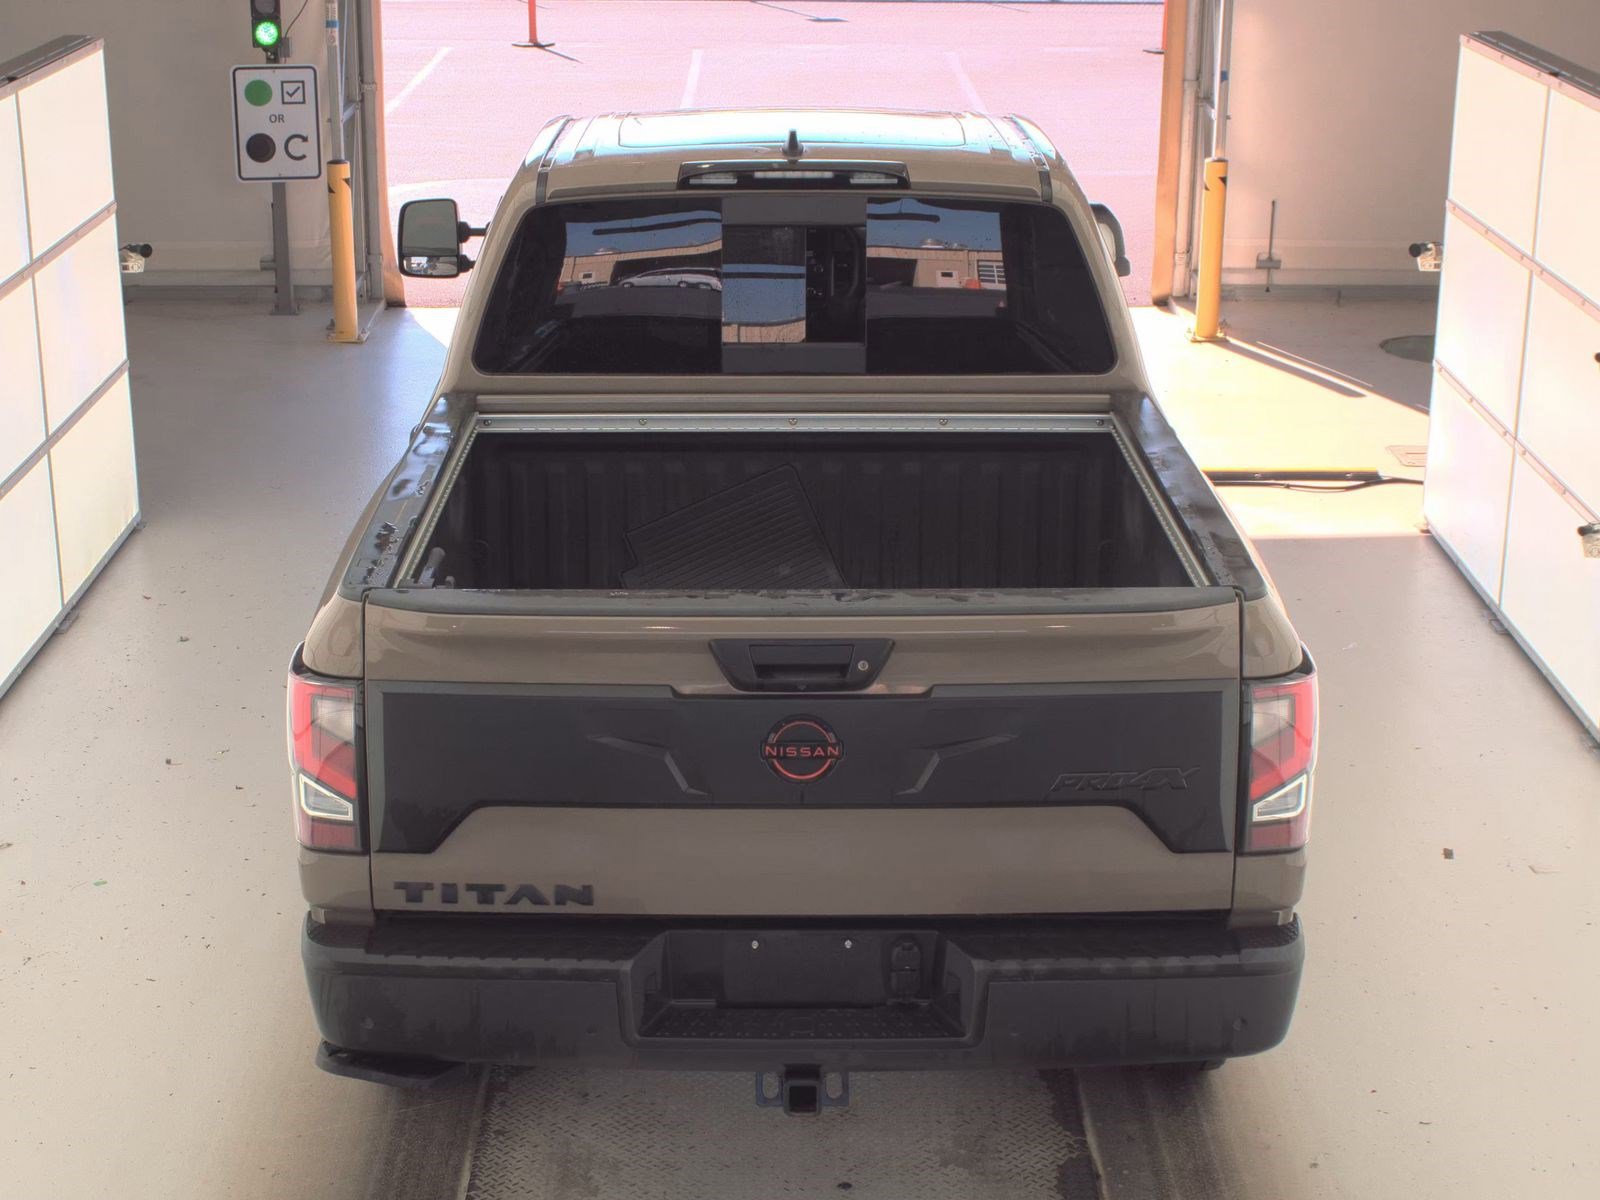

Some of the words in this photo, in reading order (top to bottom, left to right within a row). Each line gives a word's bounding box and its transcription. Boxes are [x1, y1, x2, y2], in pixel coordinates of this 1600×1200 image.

[269, 114, 285, 123] OR
[765, 746, 839, 757] NISSAN
[394, 882, 593, 906] TITAN
